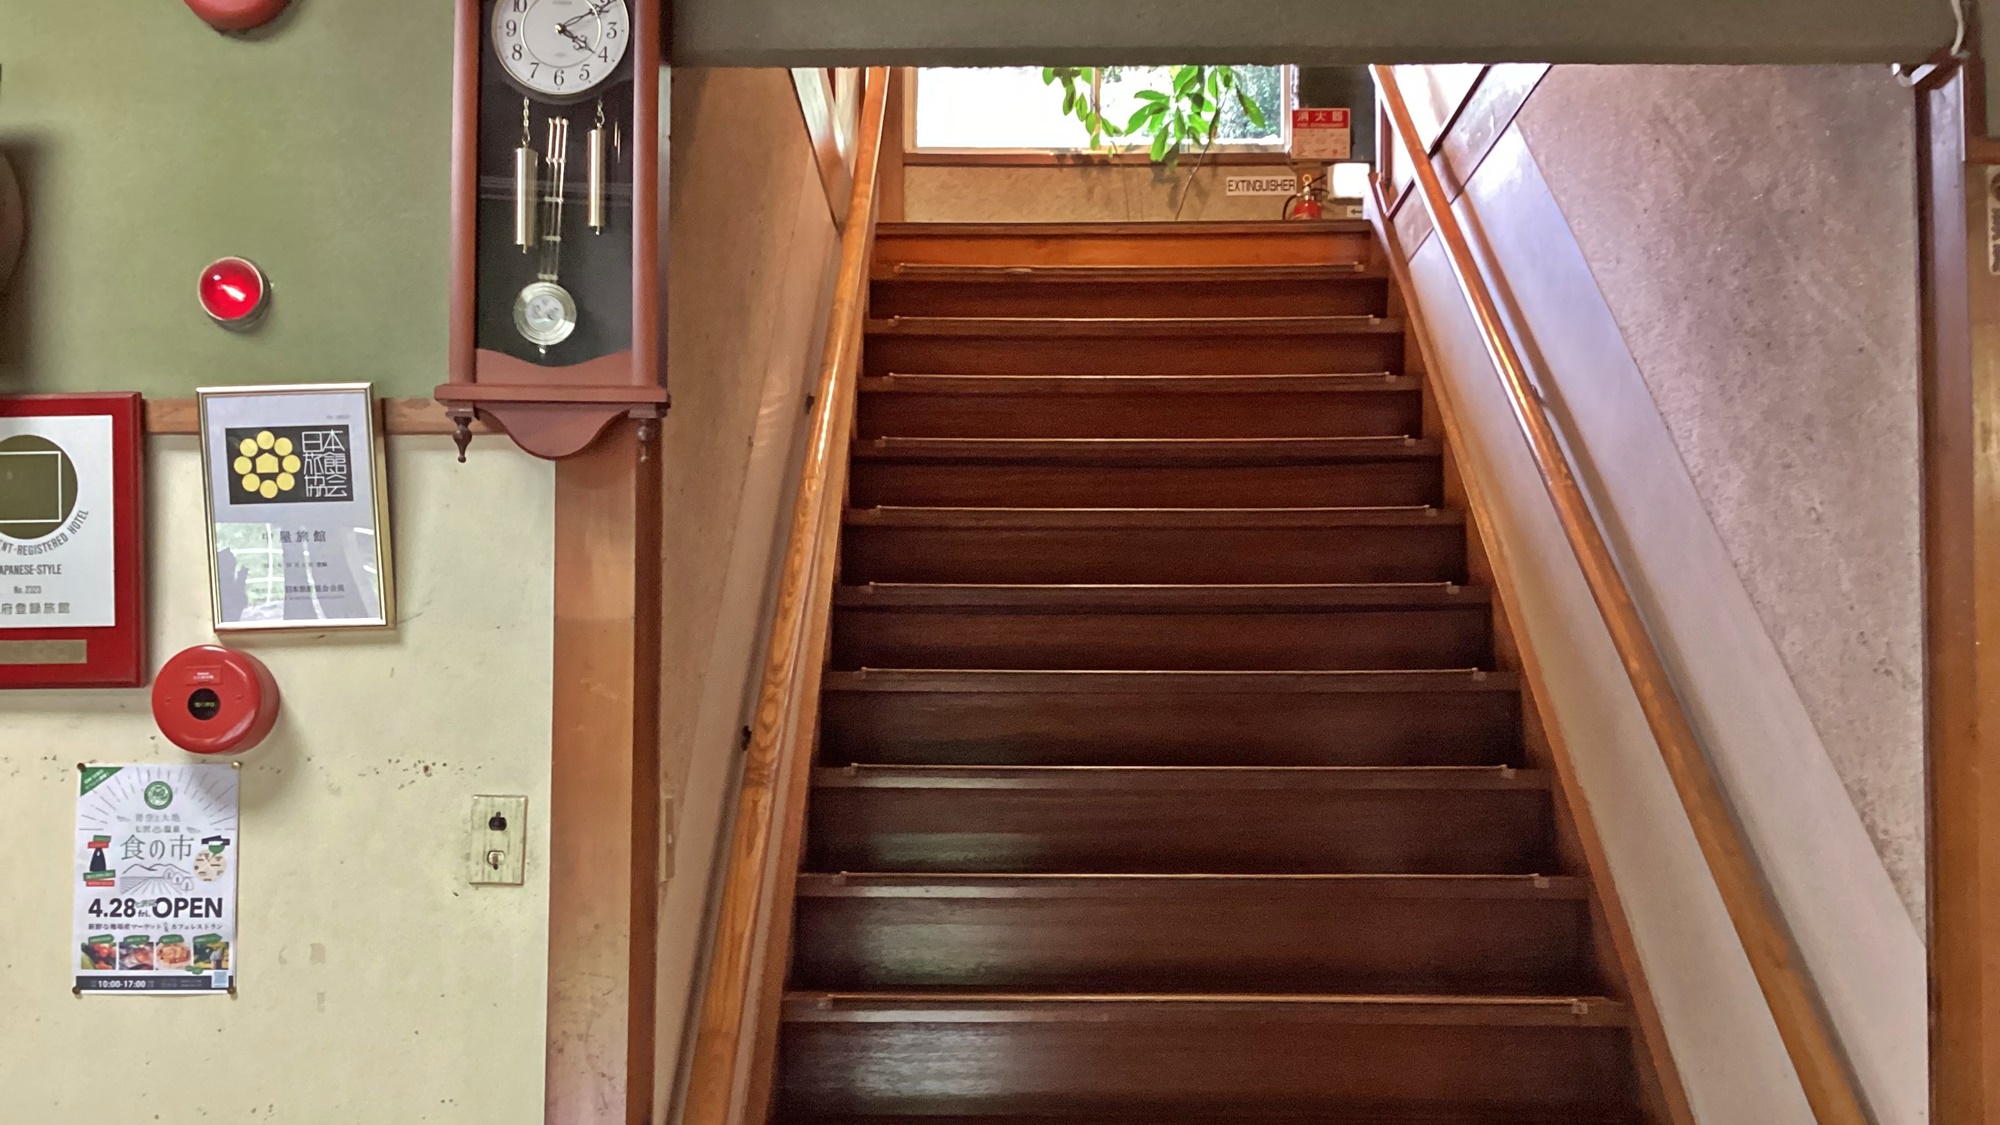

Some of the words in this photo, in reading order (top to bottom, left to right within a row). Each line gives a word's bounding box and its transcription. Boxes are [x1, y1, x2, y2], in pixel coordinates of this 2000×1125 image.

[506, 20, 516, 37] 9
[606, 22, 617, 39] 3
[512, 44, 522, 61] 8
[598, 47, 608, 63] 4
[530, 62, 540, 79] 7
[554, 69, 564, 86] 6
[579, 64, 590, 81] 5
[1227, 179, 1296, 192] EXTINGUISHER
[302, 429, 345, 452] 日本
[303, 452, 347, 475] 旅館
[67, 508, 89, 535] HOTEL
[120, 834, 194, 861] 食の市
[88, 898, 136, 918] 4.28
[152, 897, 223, 918] OPEN
[98, 980, 147, 988] 10:00-17:00
